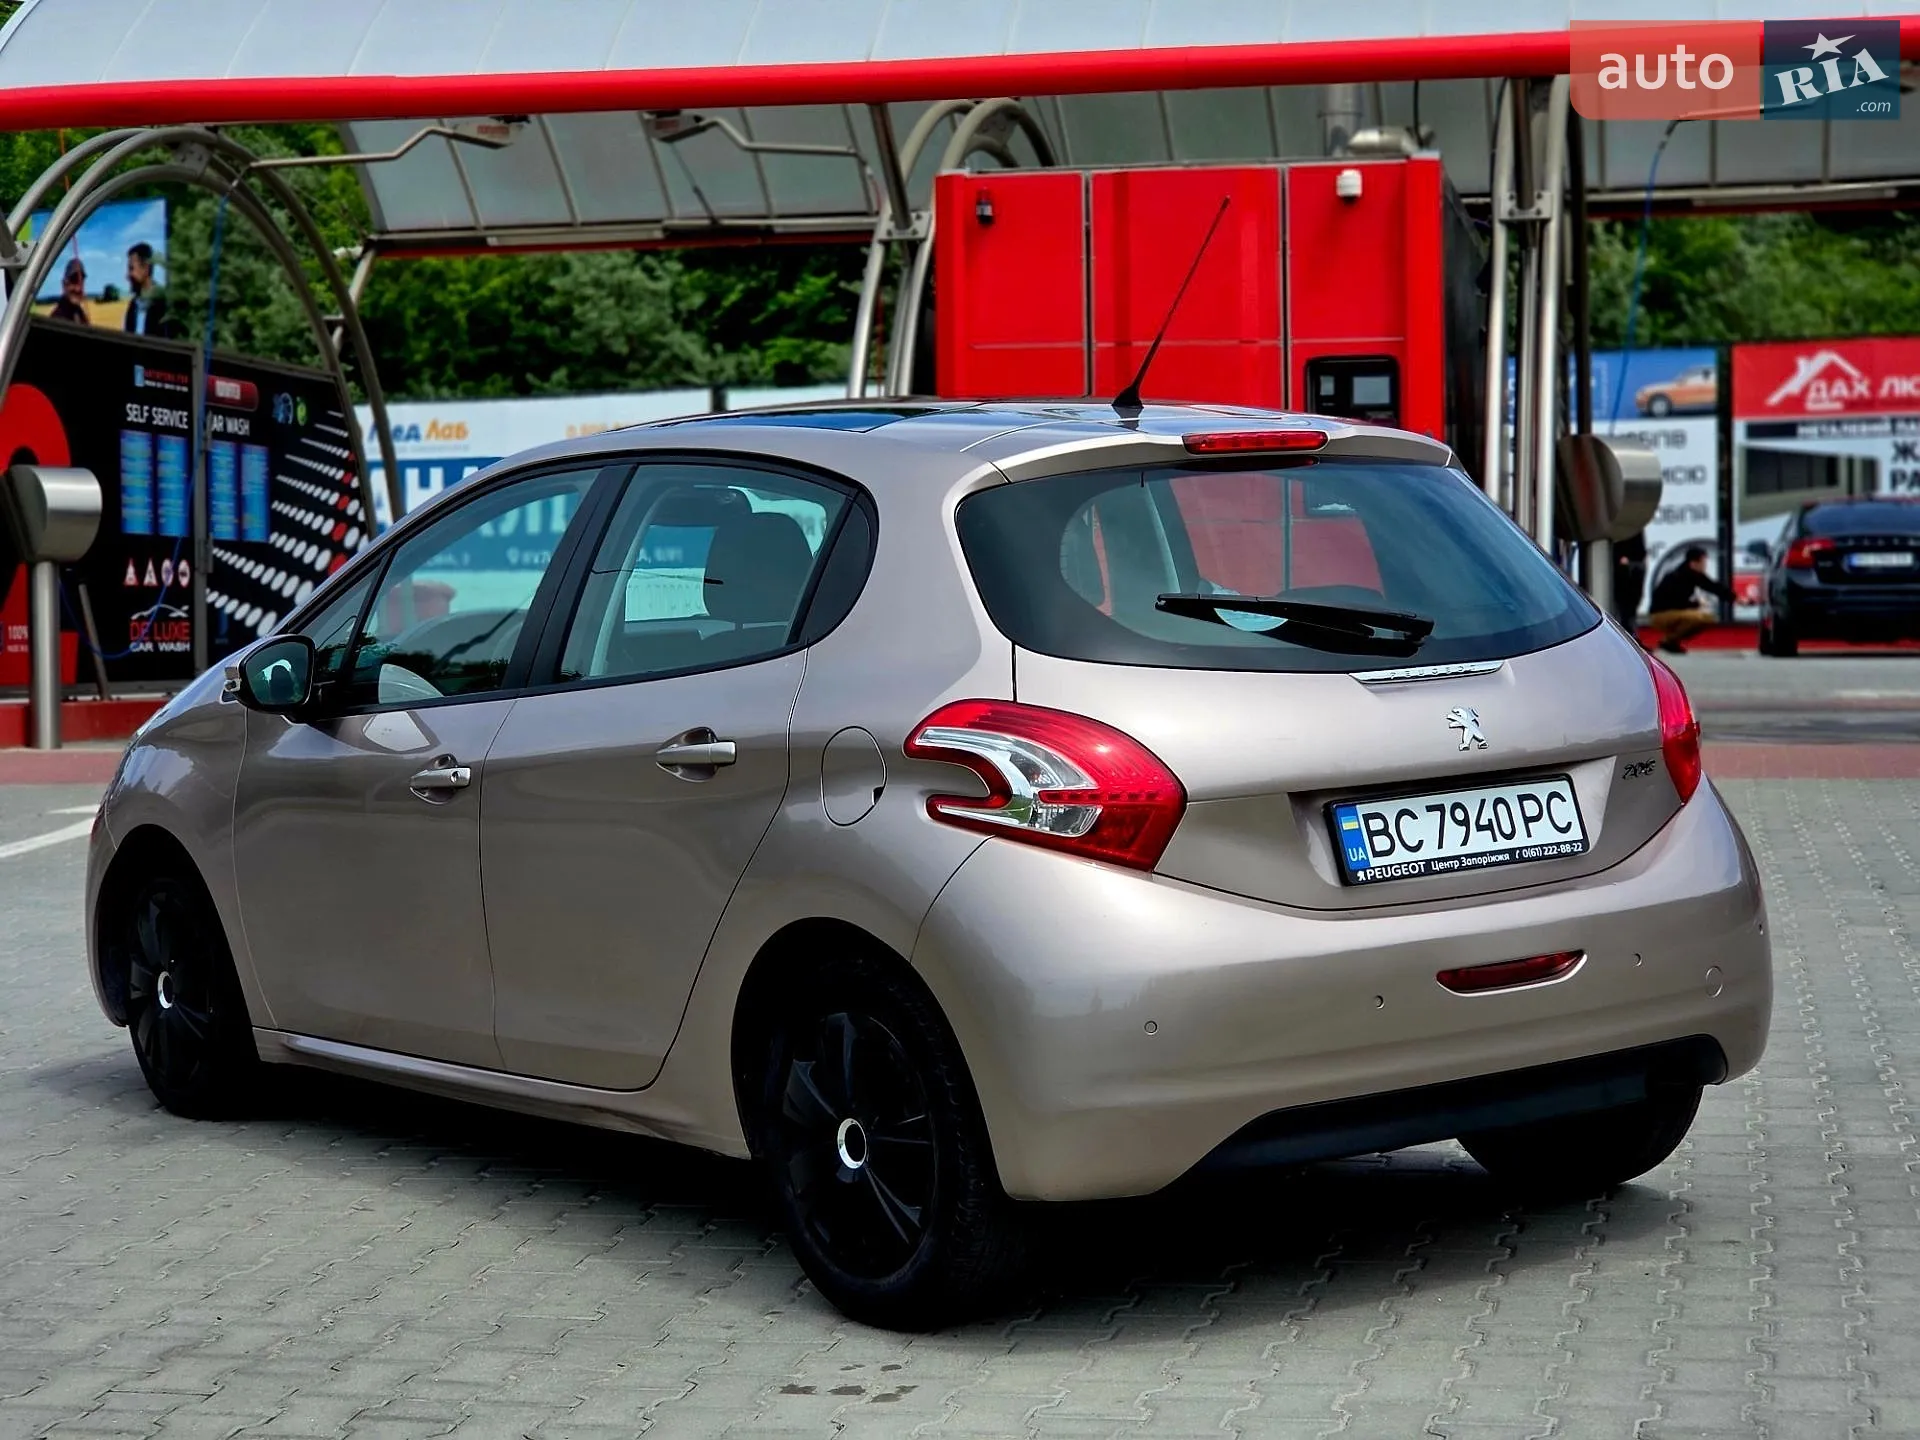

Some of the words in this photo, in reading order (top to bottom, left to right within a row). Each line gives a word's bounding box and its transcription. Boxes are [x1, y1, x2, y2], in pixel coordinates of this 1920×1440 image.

[126, 402, 149, 424] SELF
[151, 406, 189, 430] SERVICE
[225, 417, 250, 437] WASH
[130, 621, 150, 641] DE
[154, 621, 190, 641] LUXE
[129, 641, 154, 653] CAR
[158, 641, 191, 653] WASH
[1348, 847, 1368, 862] UA
[1366, 861, 1426, 881] PEUGEOT
[1430, 859, 1460, 872] Центр
[1461, 852, 1510, 867] Запоріжжя
[1543, 842, 1583, 856] 222-88-22
